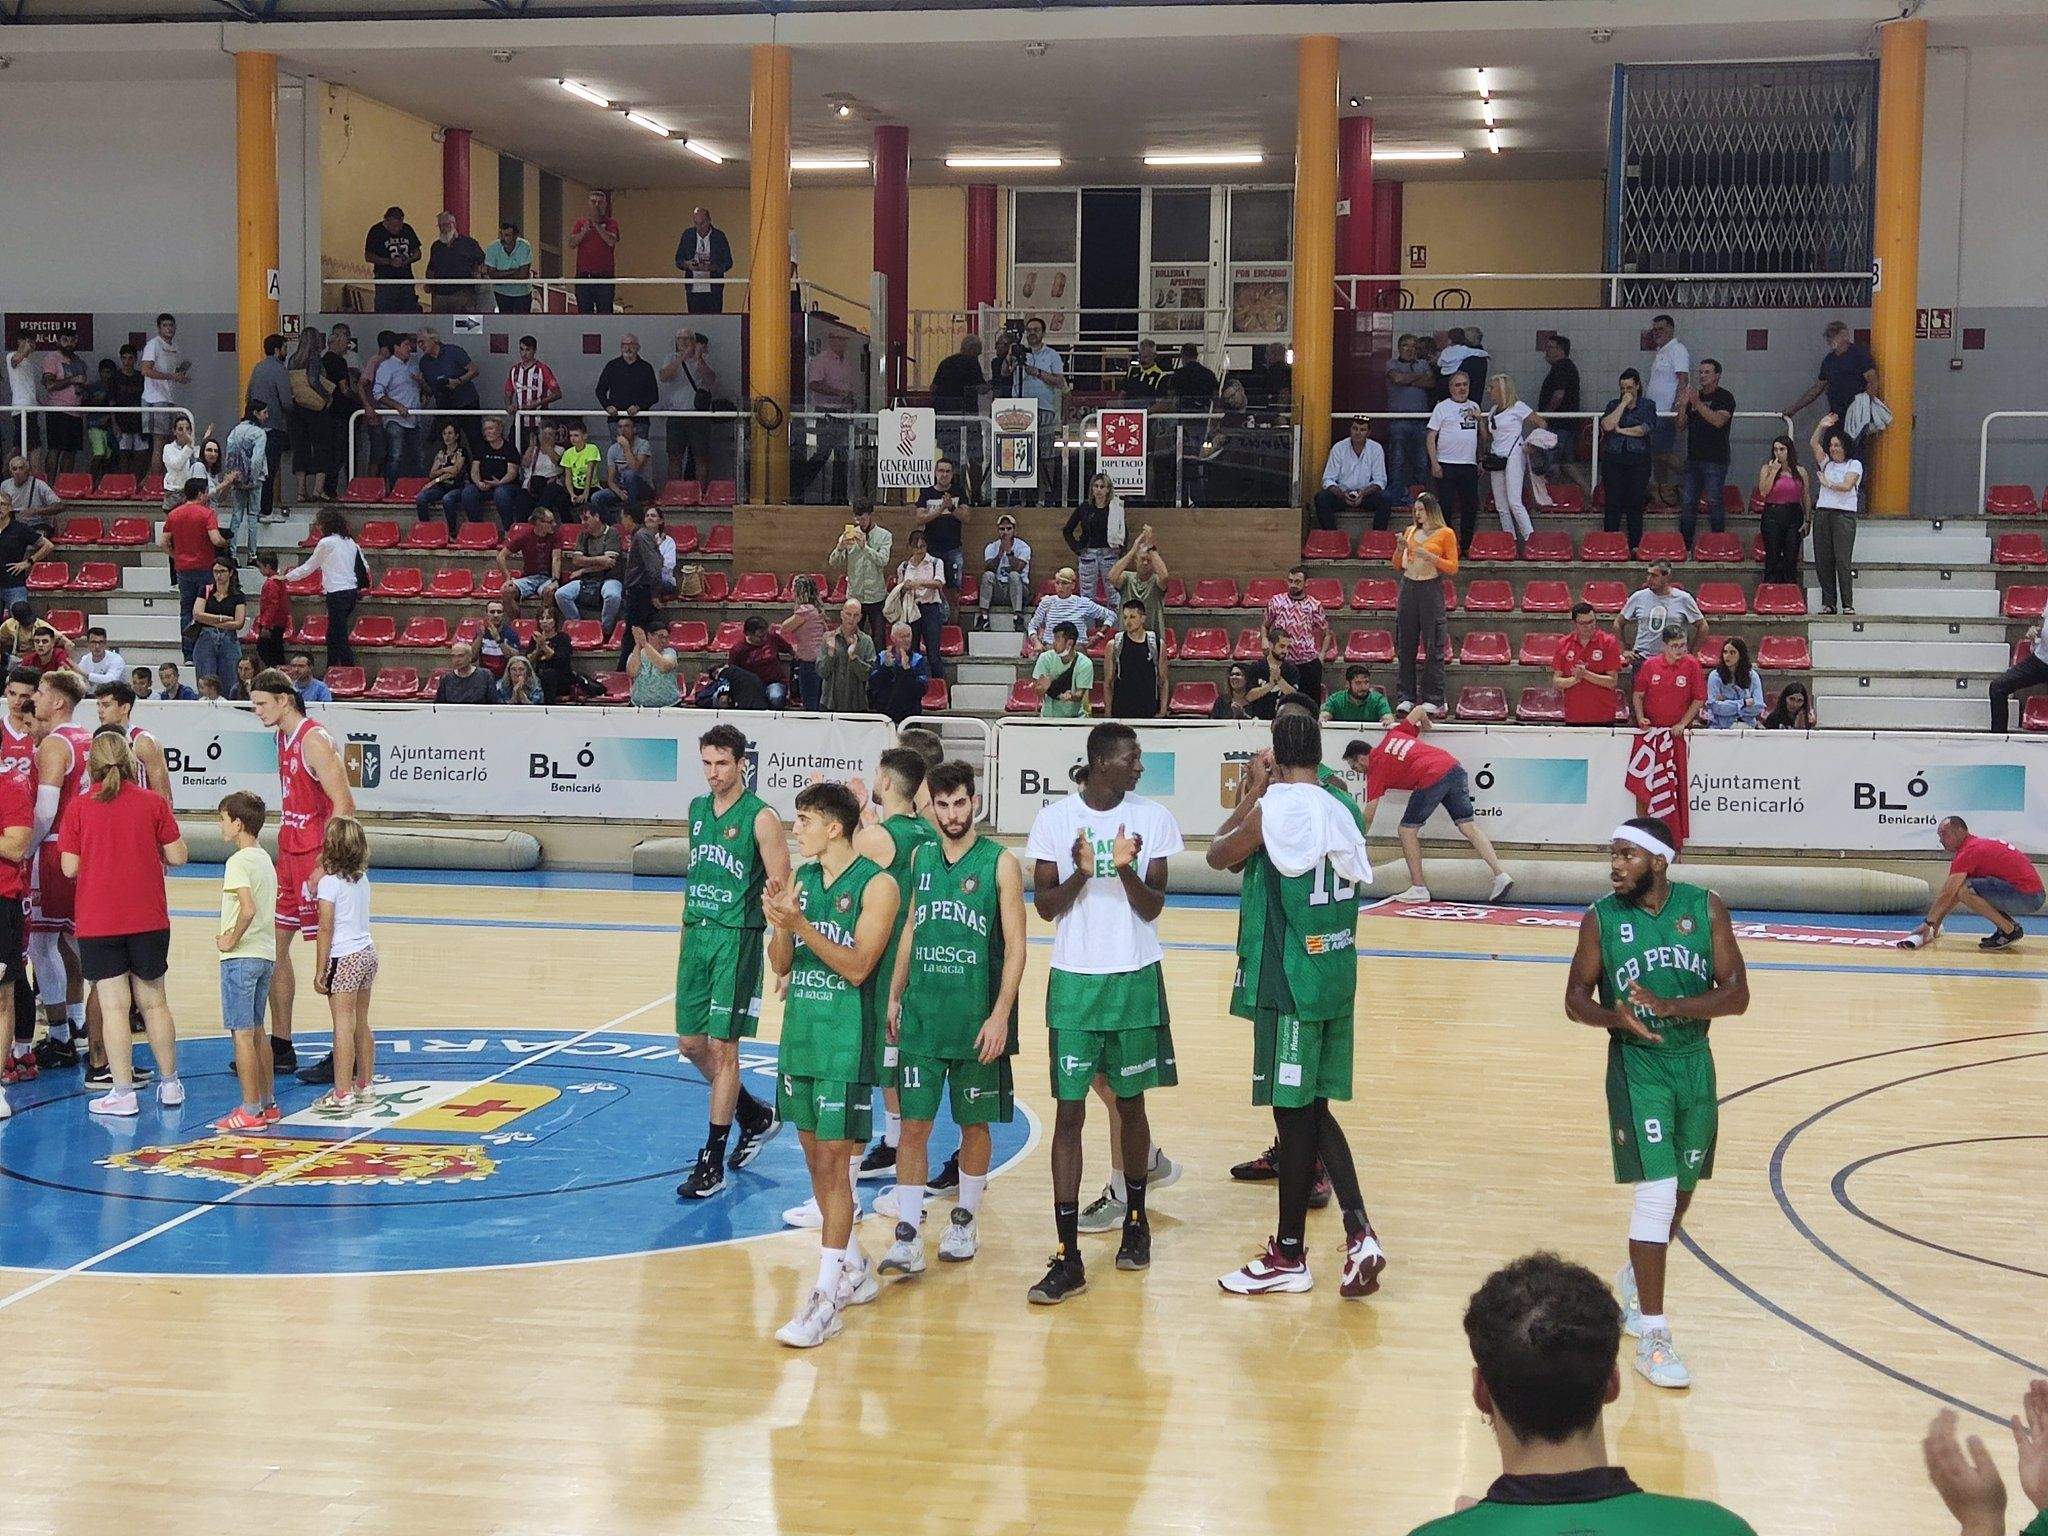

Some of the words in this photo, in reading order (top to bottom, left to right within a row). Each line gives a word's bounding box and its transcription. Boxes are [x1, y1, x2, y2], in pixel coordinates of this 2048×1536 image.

[269, 272, 280, 294] A
[879, 459, 933, 472] GENERALITAT
[880, 472, 933, 486] VALENCIANA
[389, 745, 486, 763] Ajuntament
[529, 741, 596, 779] BLÓ
[767, 752, 864, 772] Ajuntament
[182, 775, 227, 786] Benicarló
[389, 766, 408, 781] de
[413, 765, 488, 782] Benicarló
[767, 773, 788, 788] de
[551, 782, 602, 794] Benicarló
[1689, 774, 1801, 793] Ajuntament
[1854, 770, 1929, 810] BLÓ
[1473, 805, 1503, 817] carló
[1689, 796, 1711, 812] de
[1717, 796, 1805, 813] Benicarló
[692, 820, 702, 836] 8
[1878, 814, 1938, 826] Benicarló
[698, 844, 744, 880] PEÑAS
[918, 872, 931, 891] 11
[688, 882, 733, 903] uesca
[931, 900, 987, 937] PEÑAS
[1620, 923, 1634, 943] 9
[1616, 957, 1640, 992] CB
[1643, 944, 1707, 981] PEÑAS
[784, 1075, 793, 1097] 5
[903, 1066, 921, 1088] 11
[1644, 1118, 1663, 1143] 9
